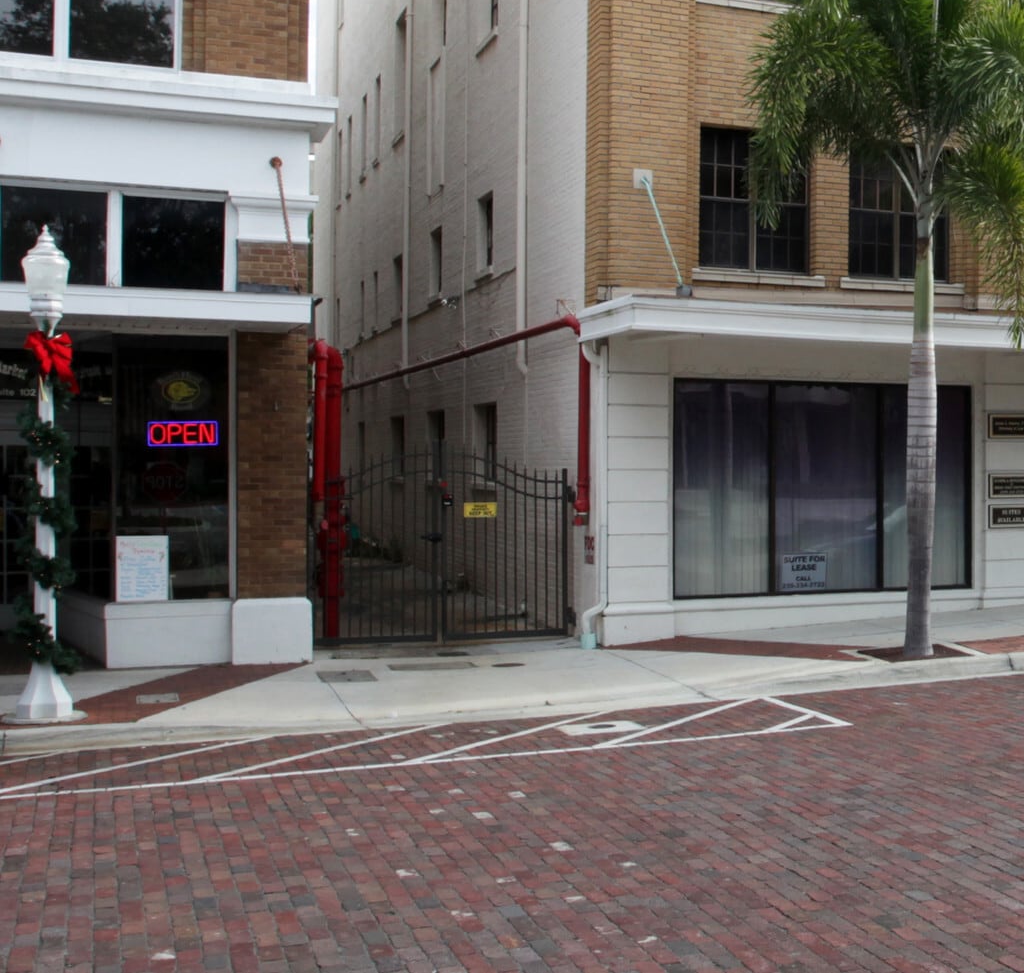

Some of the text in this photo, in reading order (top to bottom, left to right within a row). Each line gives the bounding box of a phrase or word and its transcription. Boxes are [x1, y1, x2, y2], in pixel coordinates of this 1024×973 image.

[20, 388, 37, 397] 102
[149, 423, 215, 444] OPEN
[783, 555, 826, 564] SUITE FOR
[791, 563, 817, 572] LEASE
